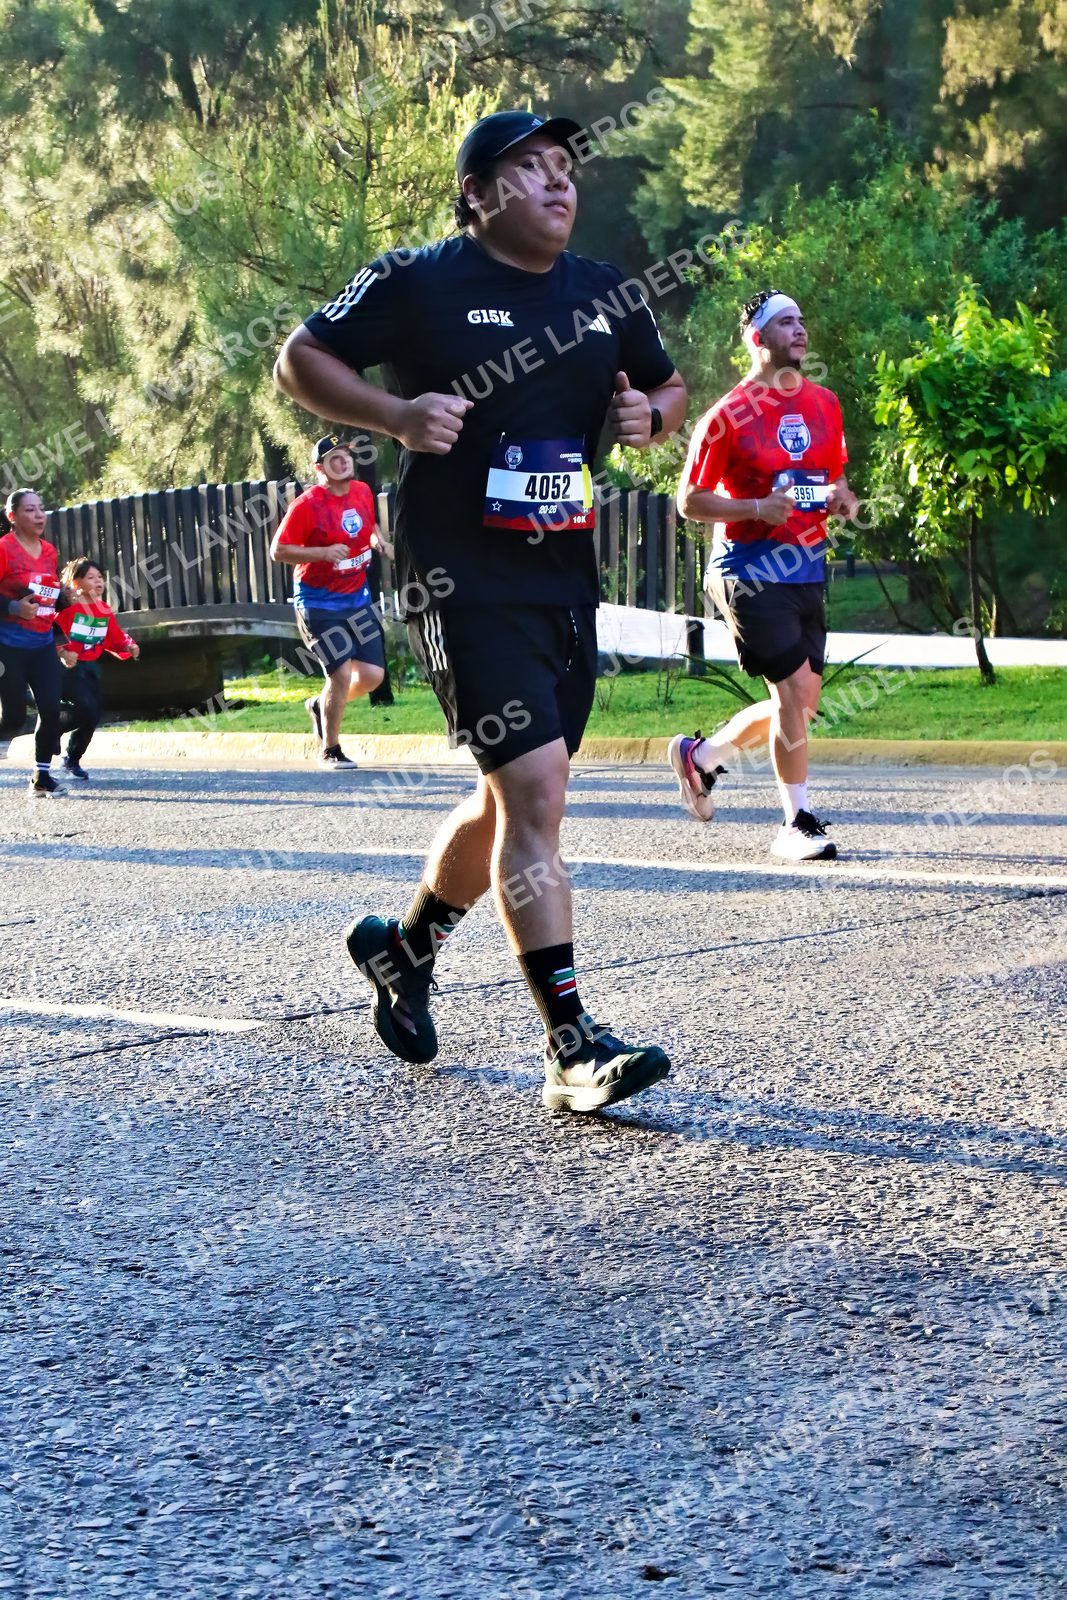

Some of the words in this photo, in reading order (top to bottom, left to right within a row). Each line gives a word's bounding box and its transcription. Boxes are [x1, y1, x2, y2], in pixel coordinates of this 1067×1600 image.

[467, 309, 513, 325] G15K
[330, 435, 340, 446] P
[525, 474, 571, 500] 4052
[794, 487, 815, 500] 3951
[538, 504, 558, 514] 20-26
[573, 515, 587, 524] 10K
